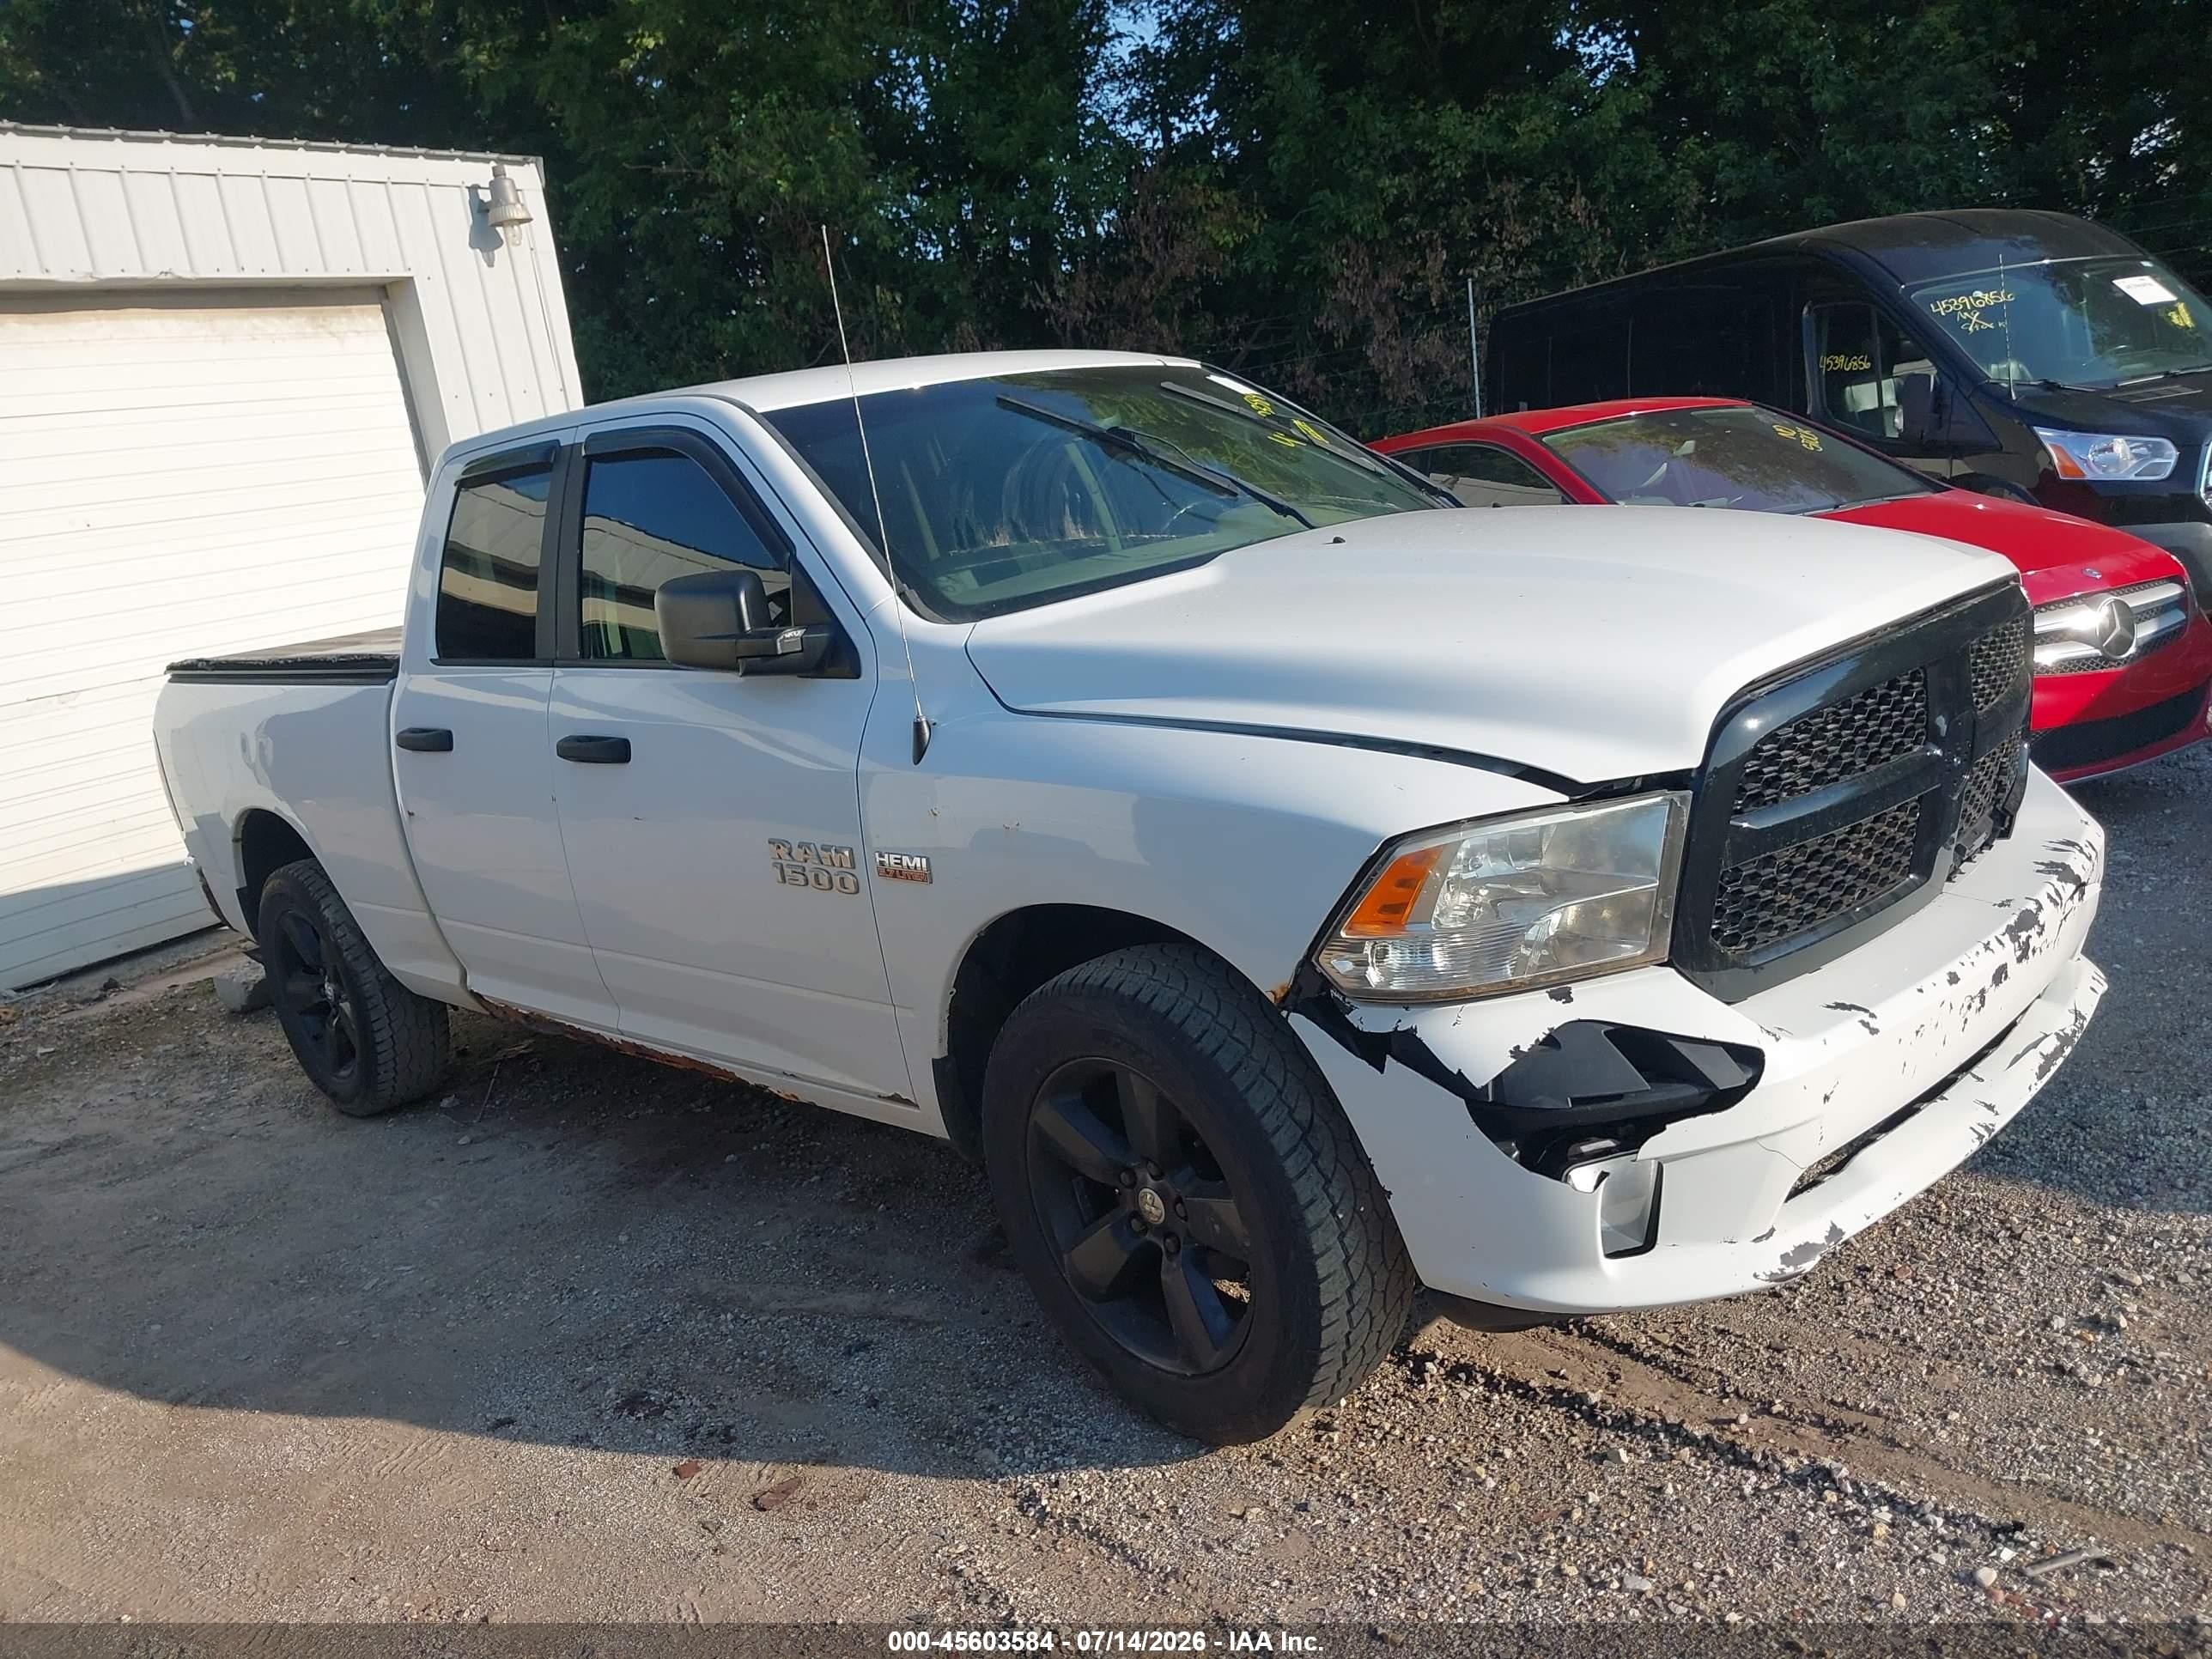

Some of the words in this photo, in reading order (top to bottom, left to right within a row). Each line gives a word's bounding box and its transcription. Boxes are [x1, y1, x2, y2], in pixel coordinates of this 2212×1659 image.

[1929, 290, 2015, 316] 45396856
[1819, 355, 1872, 375] 45396856
[768, 838, 856, 869] RAM
[875, 851, 930, 872] HEMI
[772, 861, 860, 895] 1500
